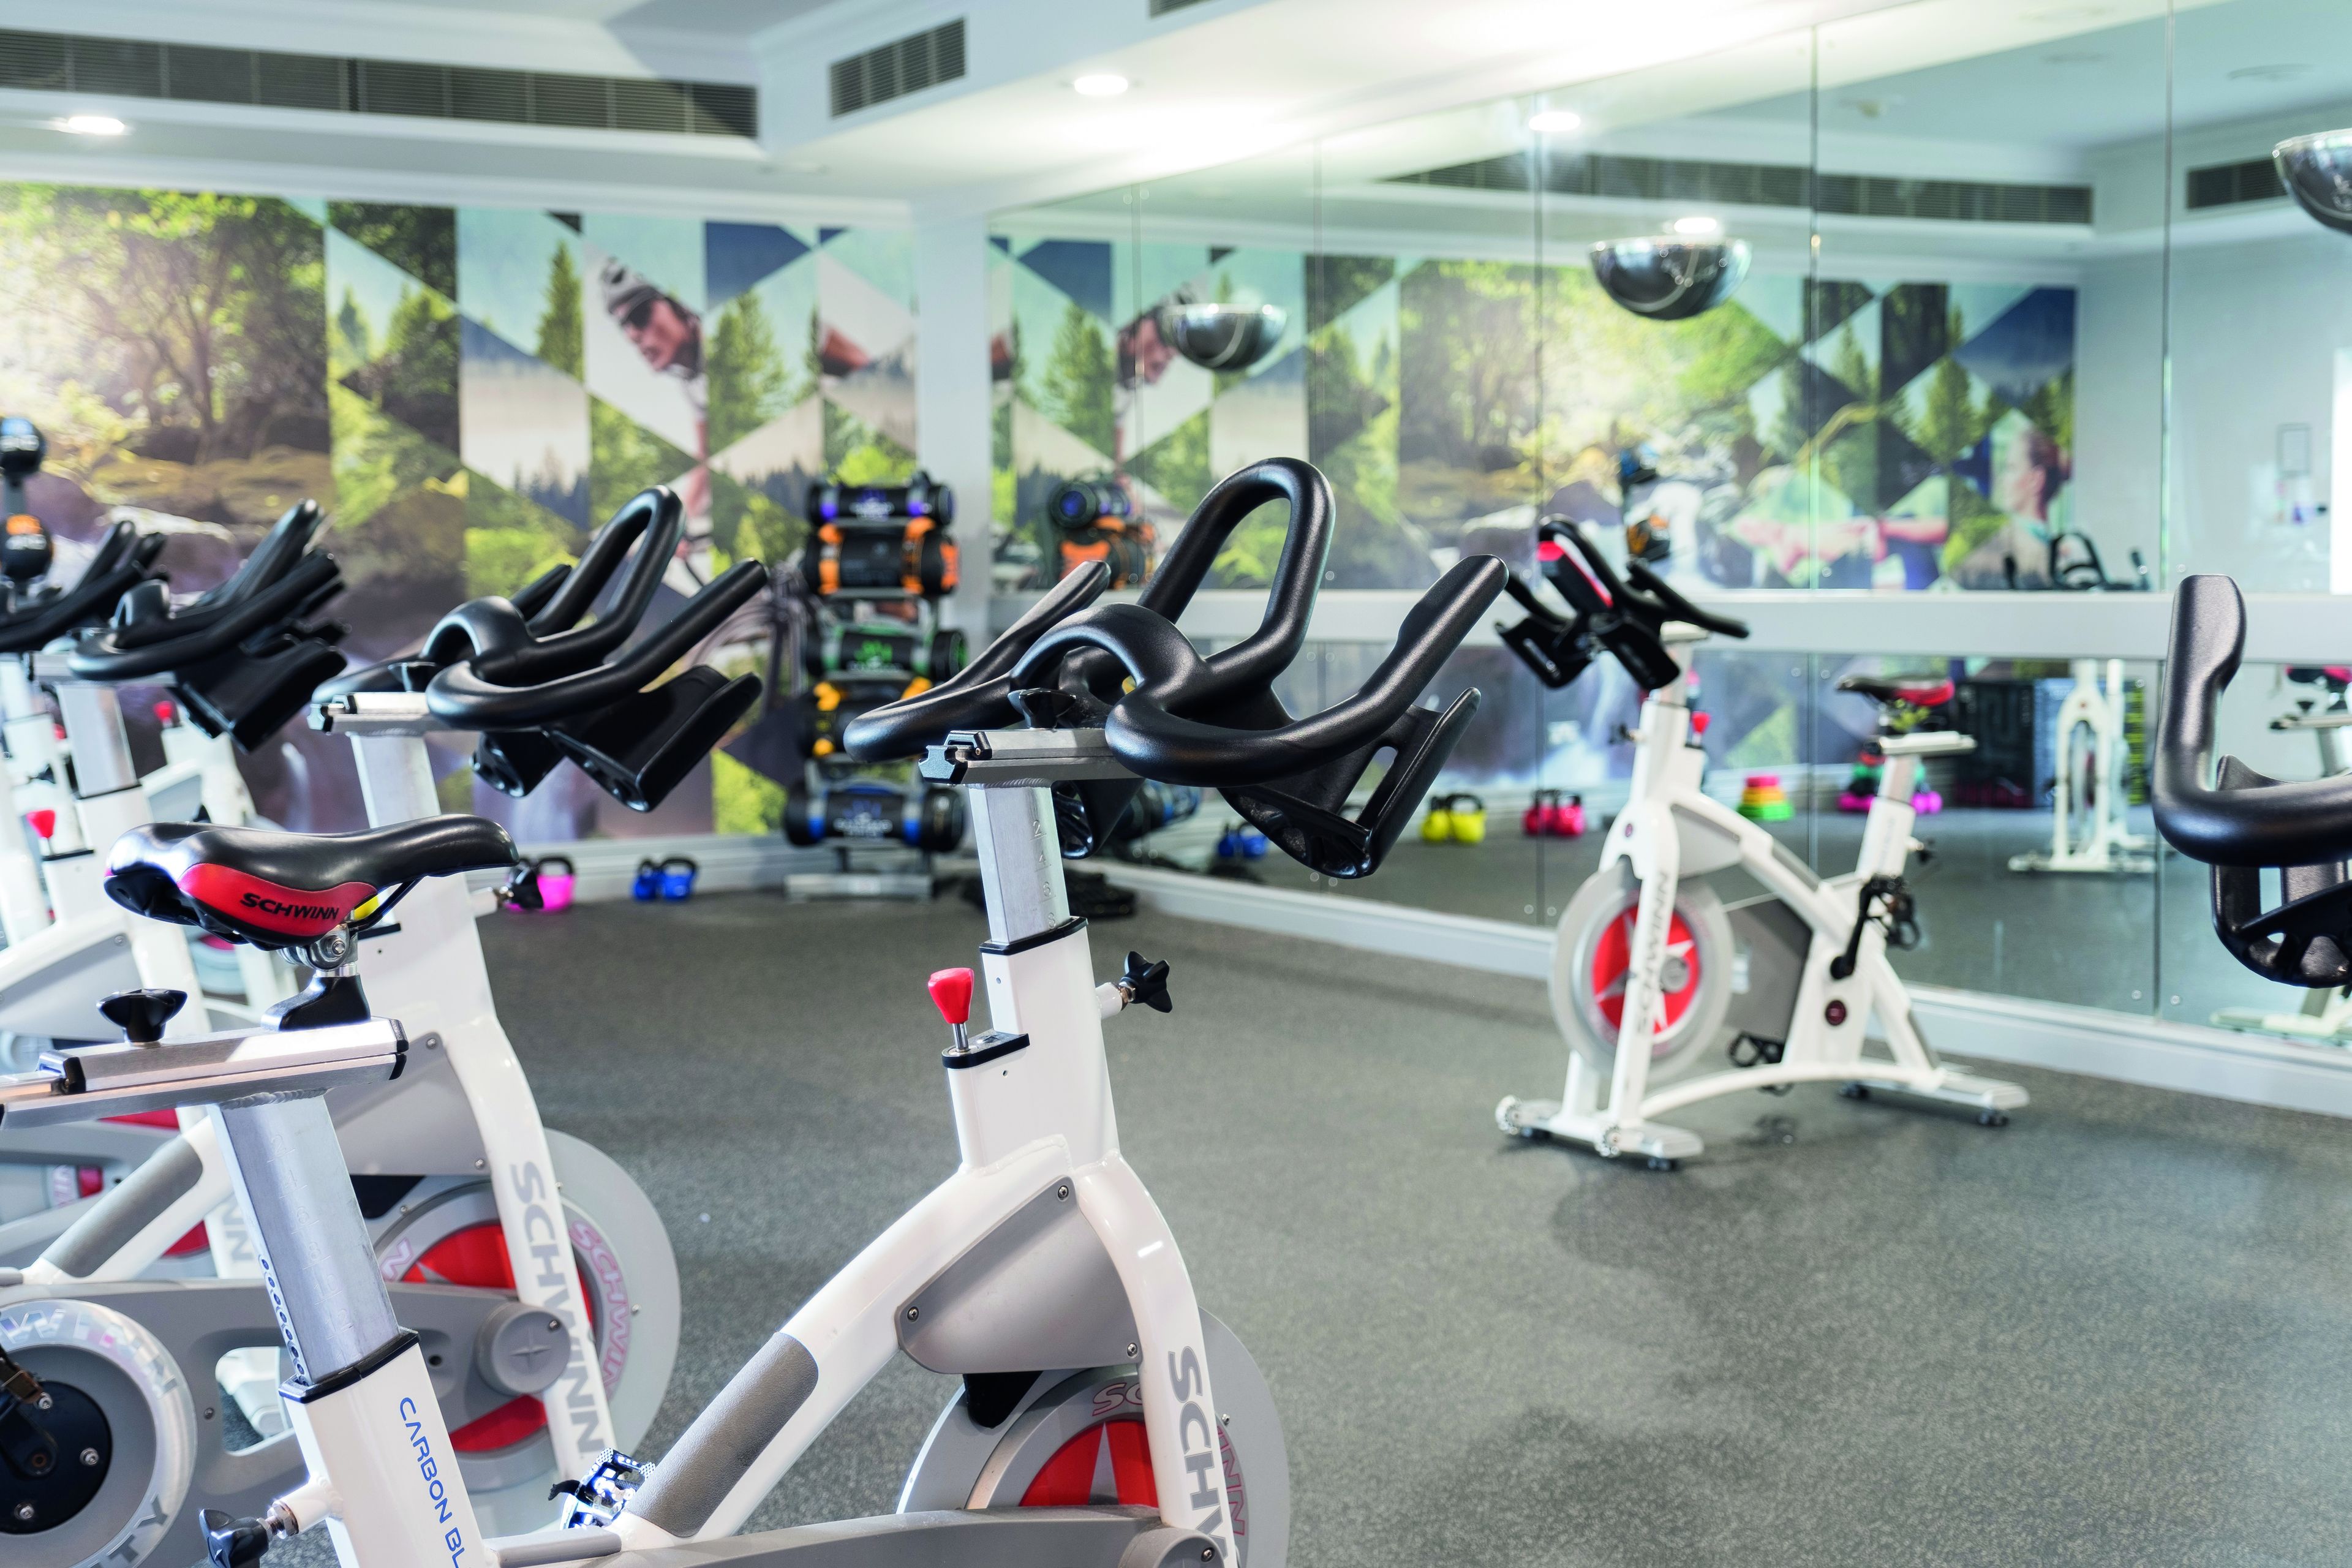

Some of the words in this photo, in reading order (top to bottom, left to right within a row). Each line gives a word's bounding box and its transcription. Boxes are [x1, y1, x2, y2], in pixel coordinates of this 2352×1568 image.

[1033, 820, 1042, 837] 2
[1043, 881, 1051, 897] 6
[239, 892, 339, 919] SCHWINN
[399, 1397, 452, 1523] CARBON
